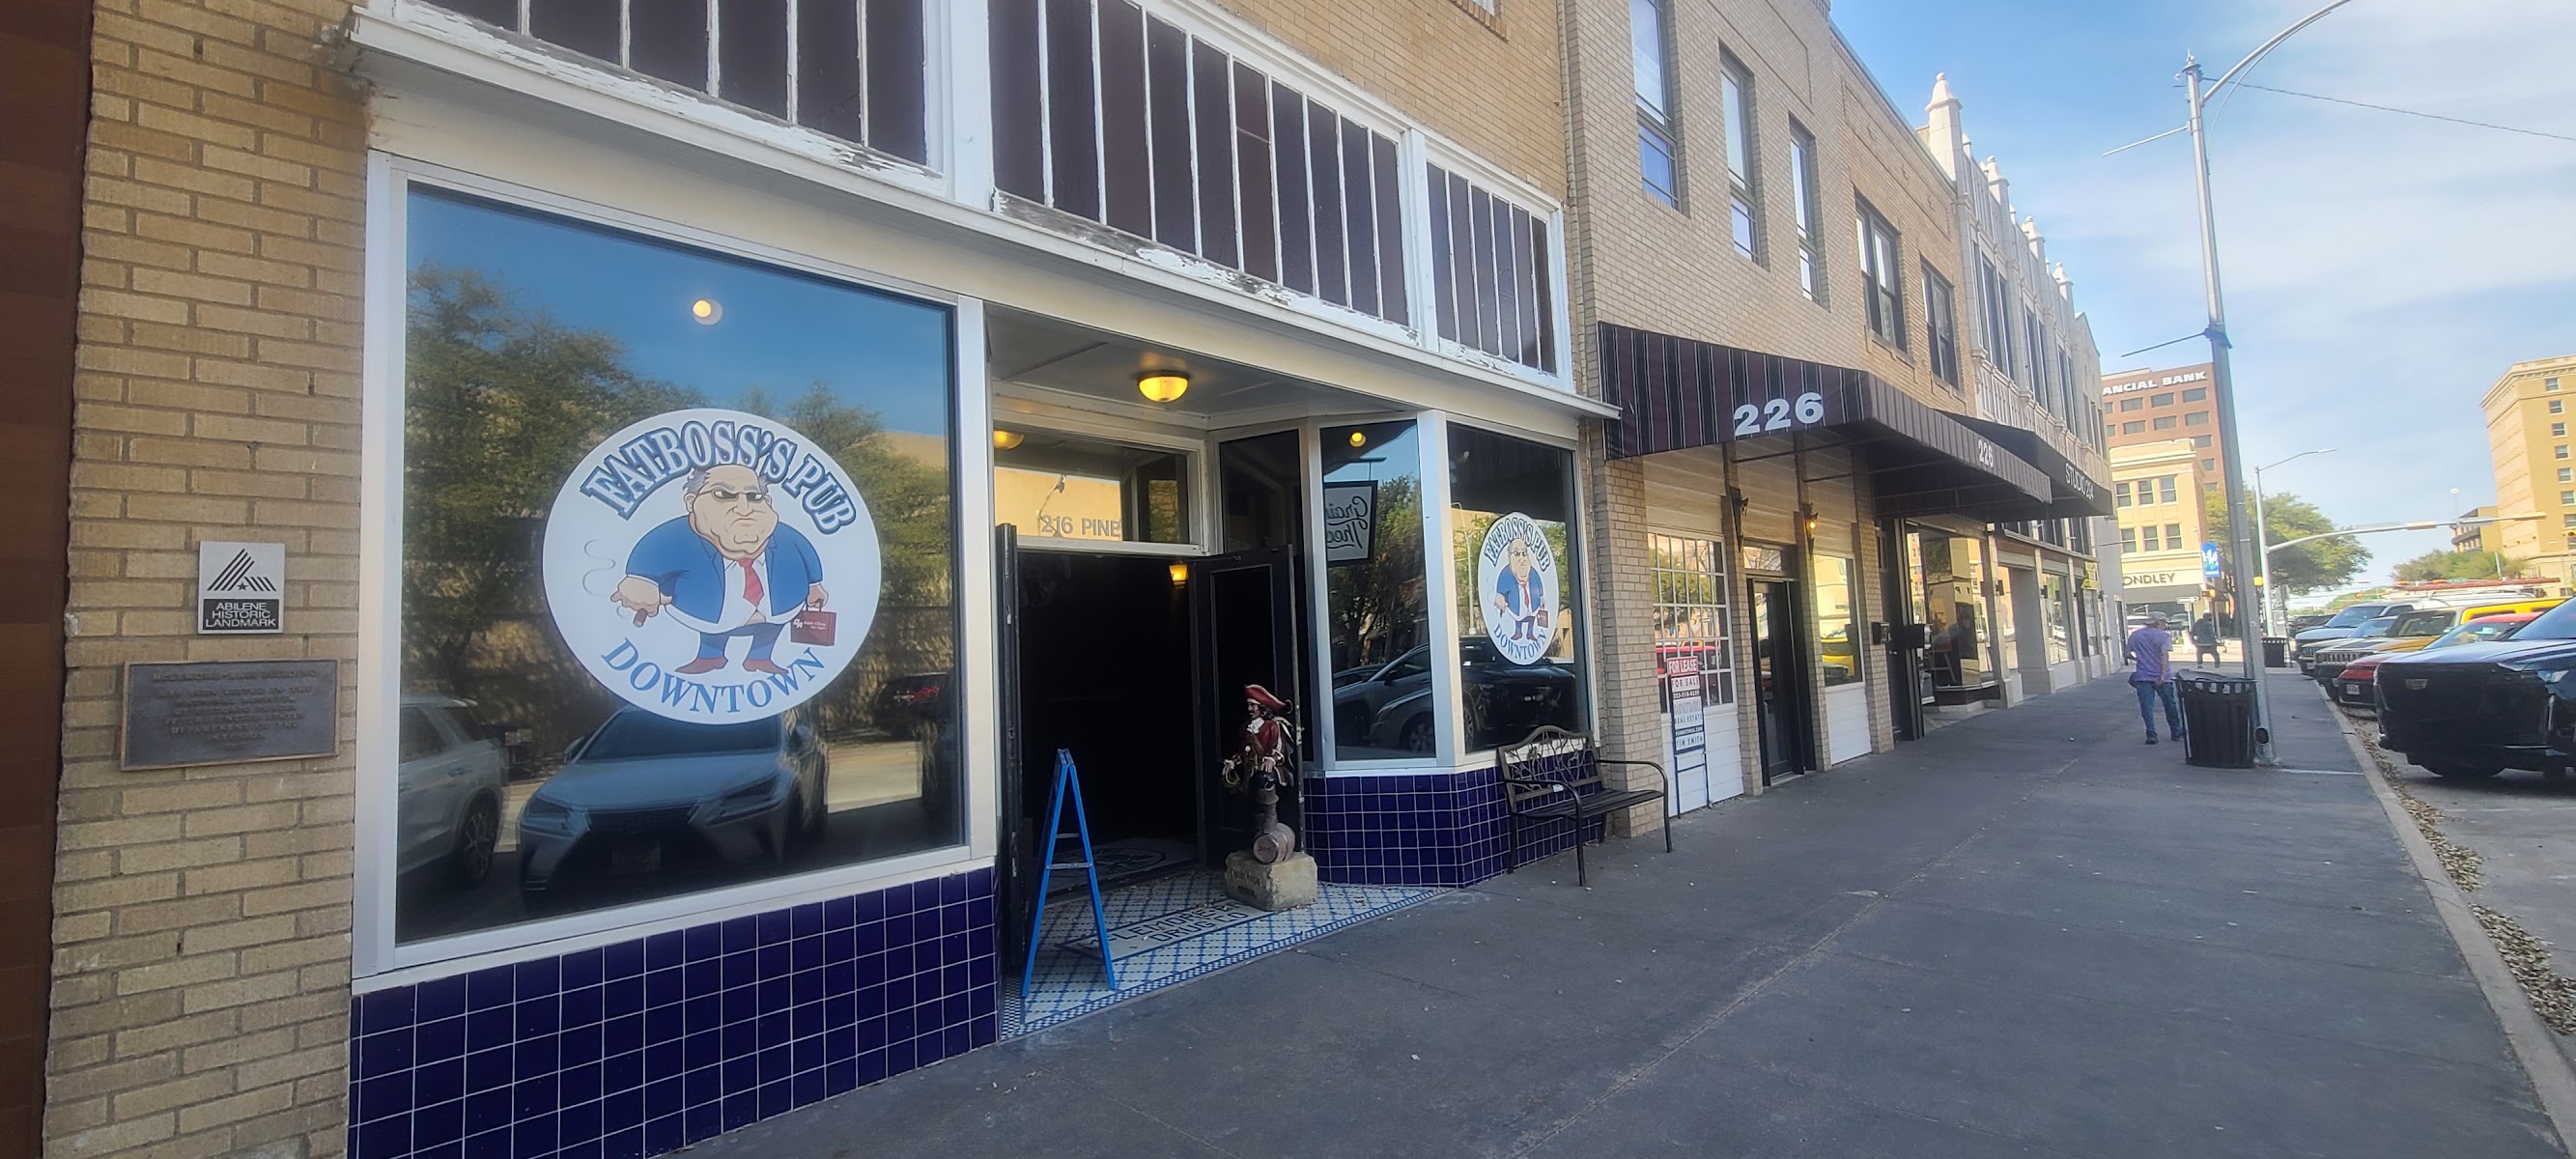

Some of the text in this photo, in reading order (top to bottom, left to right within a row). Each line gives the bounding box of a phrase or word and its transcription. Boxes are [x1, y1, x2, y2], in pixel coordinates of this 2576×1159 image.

[2102, 371, 2208, 396] ANCIAL BANK
[1734, 392, 1824, 437] 226
[1978, 438, 1995, 468] 226
[2065, 463, 2086, 495] STUDIO
[784, 452, 858, 535] PUB
[1041, 515, 1121, 537] 216 PINE
[1530, 530, 1551, 572] PUB
[212, 609, 270, 619] HISTORIC
[215, 602, 268, 610] ABILENE
[205, 618, 277, 628] LANDMARK
[1493, 623, 1547, 661] DOWNTOWN
[601, 637, 825, 714] DOWNTOWN
[1668, 659, 1697, 675] FOR LEASE
[1671, 676, 1699, 689] FOR SALE
[1687, 736, 1703, 746] SMITH
[1149, 911, 1250, 943] DRUG CO
